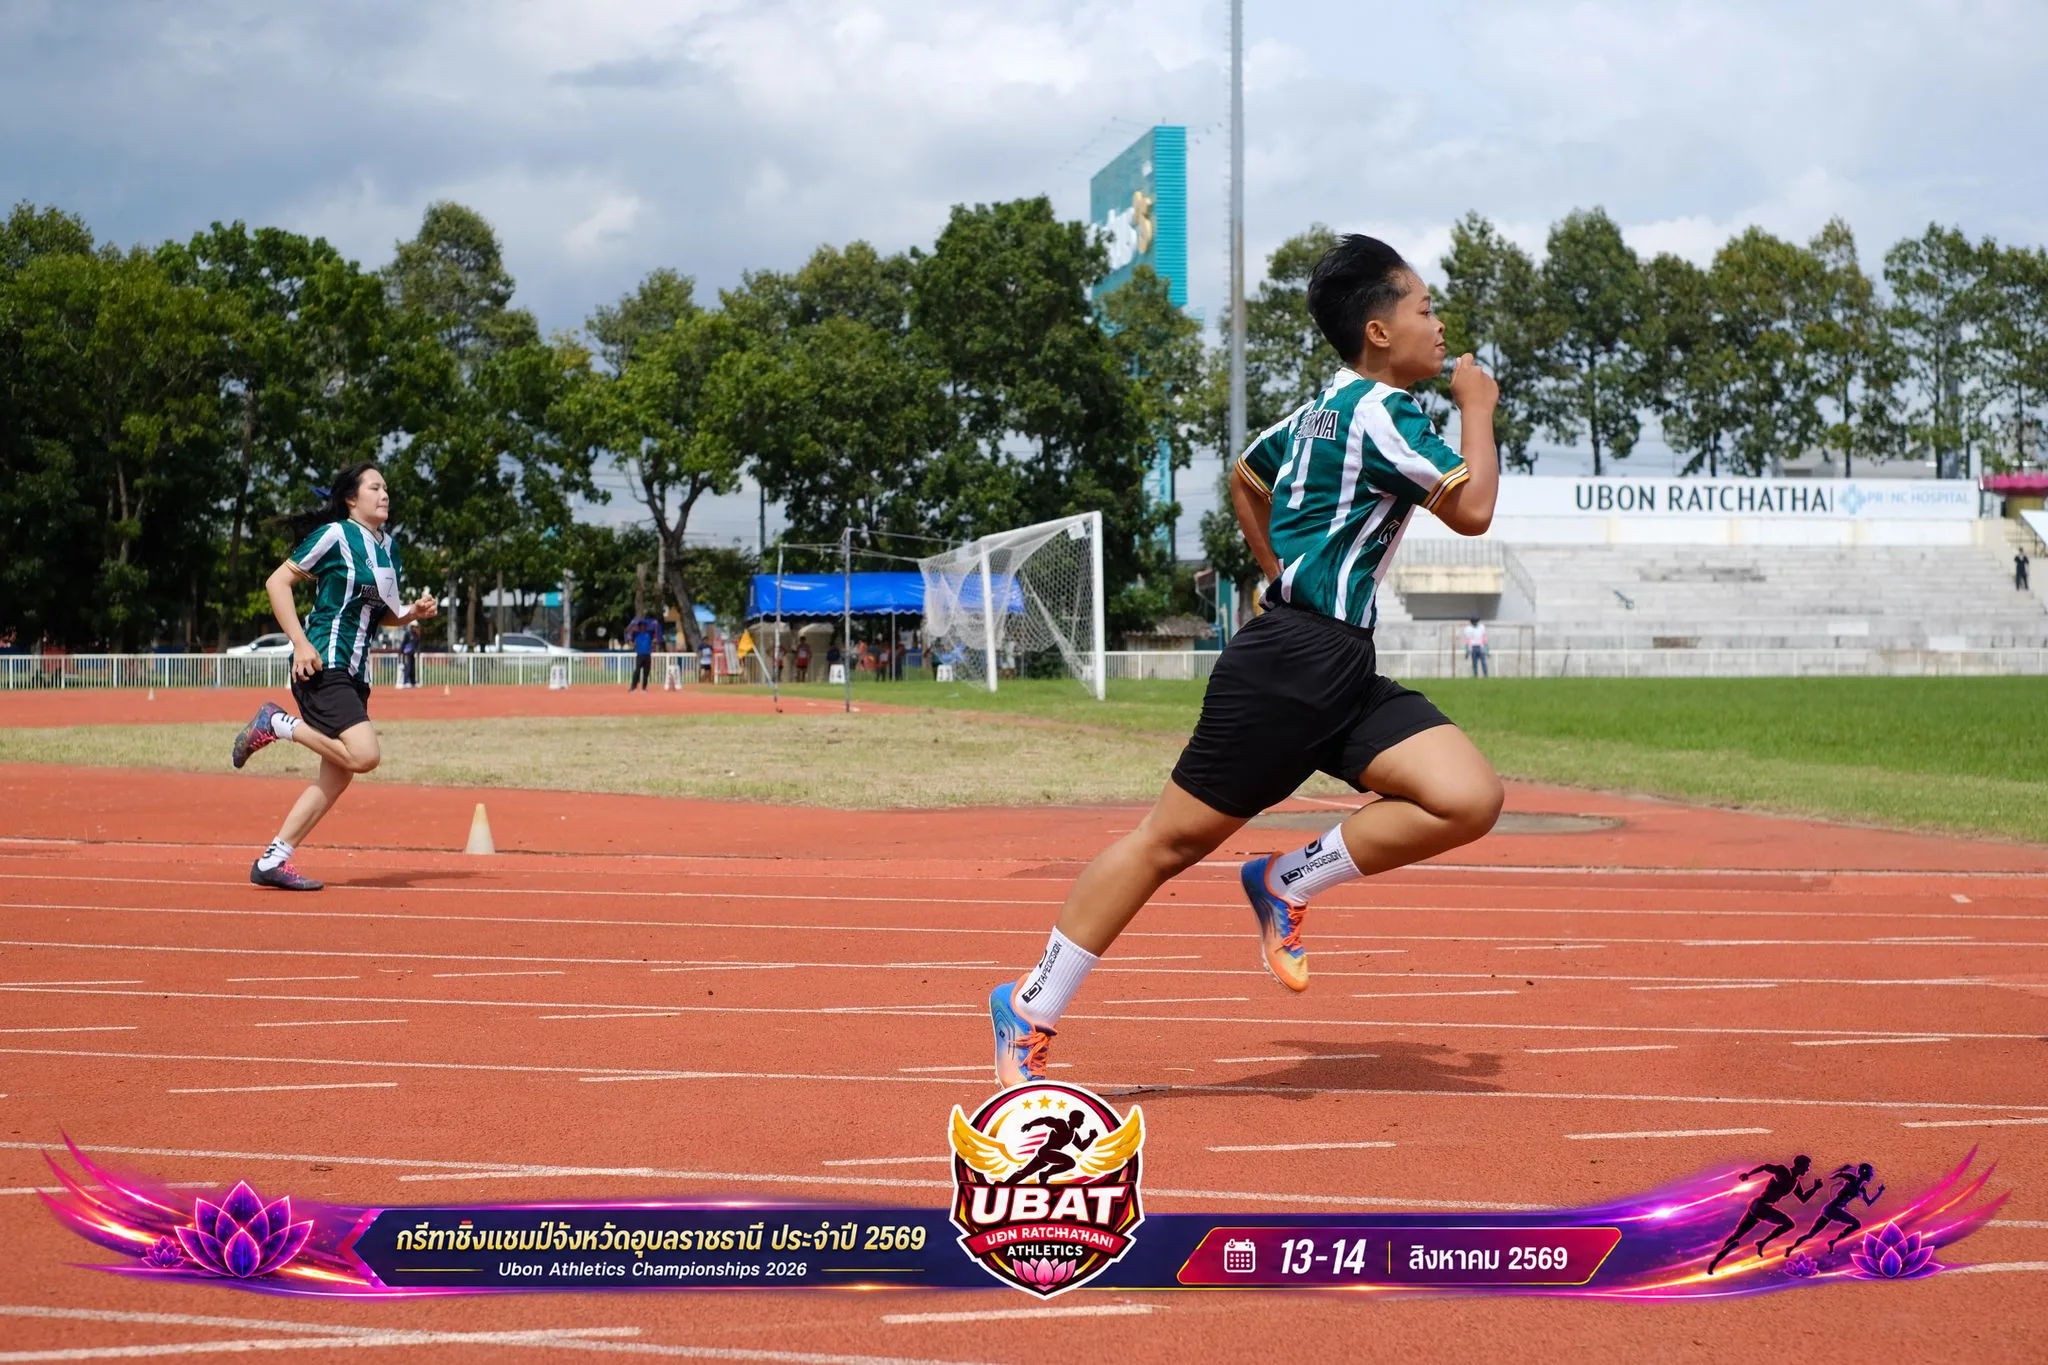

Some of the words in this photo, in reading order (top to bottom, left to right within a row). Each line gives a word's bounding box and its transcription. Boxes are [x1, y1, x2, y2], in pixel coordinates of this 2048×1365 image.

[1575, 484, 1656, 511] UBON
[1667, 484, 1834, 512] RATCHATHA
[1301, 849, 1343, 875] TAPEDESIGN
